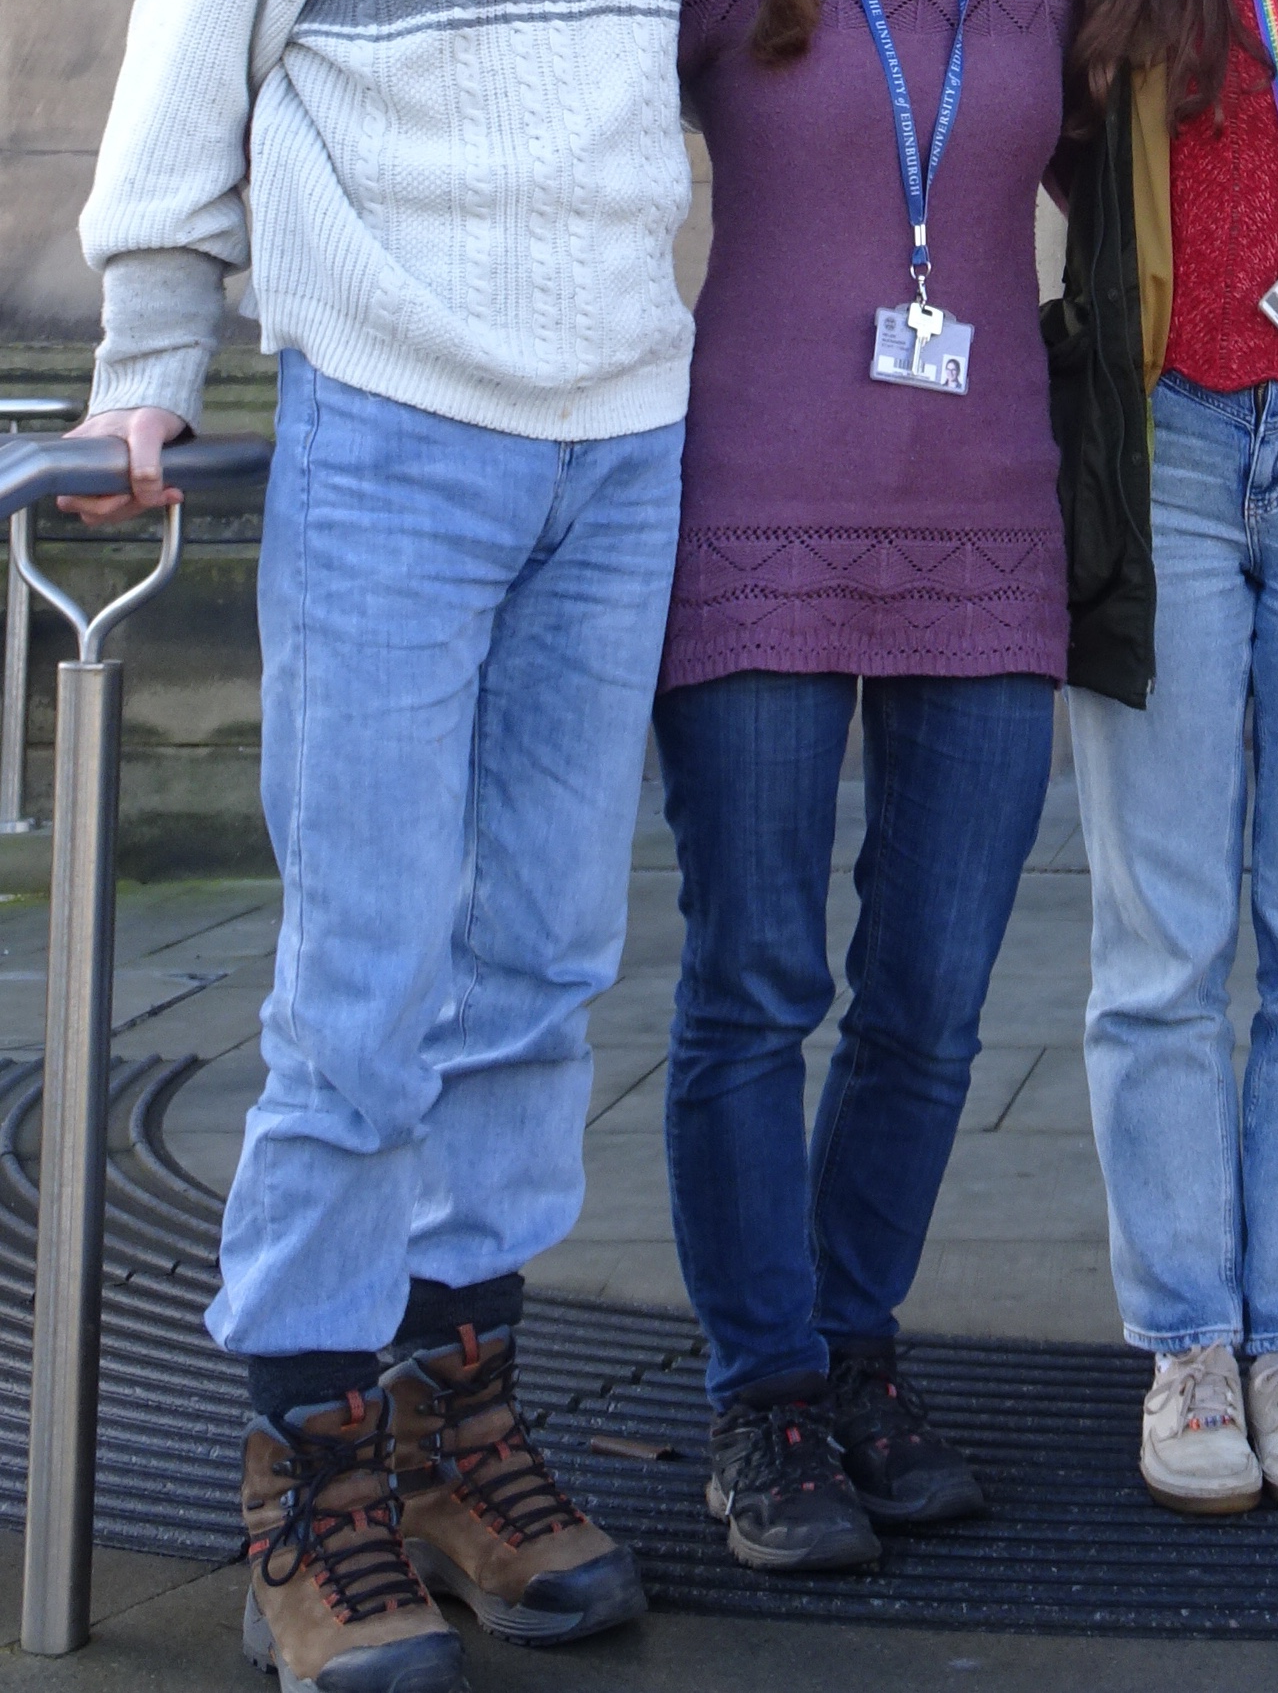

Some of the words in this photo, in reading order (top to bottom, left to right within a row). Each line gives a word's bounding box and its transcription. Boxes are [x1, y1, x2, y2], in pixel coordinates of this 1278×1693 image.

[875, 19, 907, 95] UNIVERSITY
[894, 96, 910, 109] of
[931, 86, 956, 167] UNIVERSITY
[948, 72, 961, 87] of
[900, 112, 921, 196] EDINBURGH
